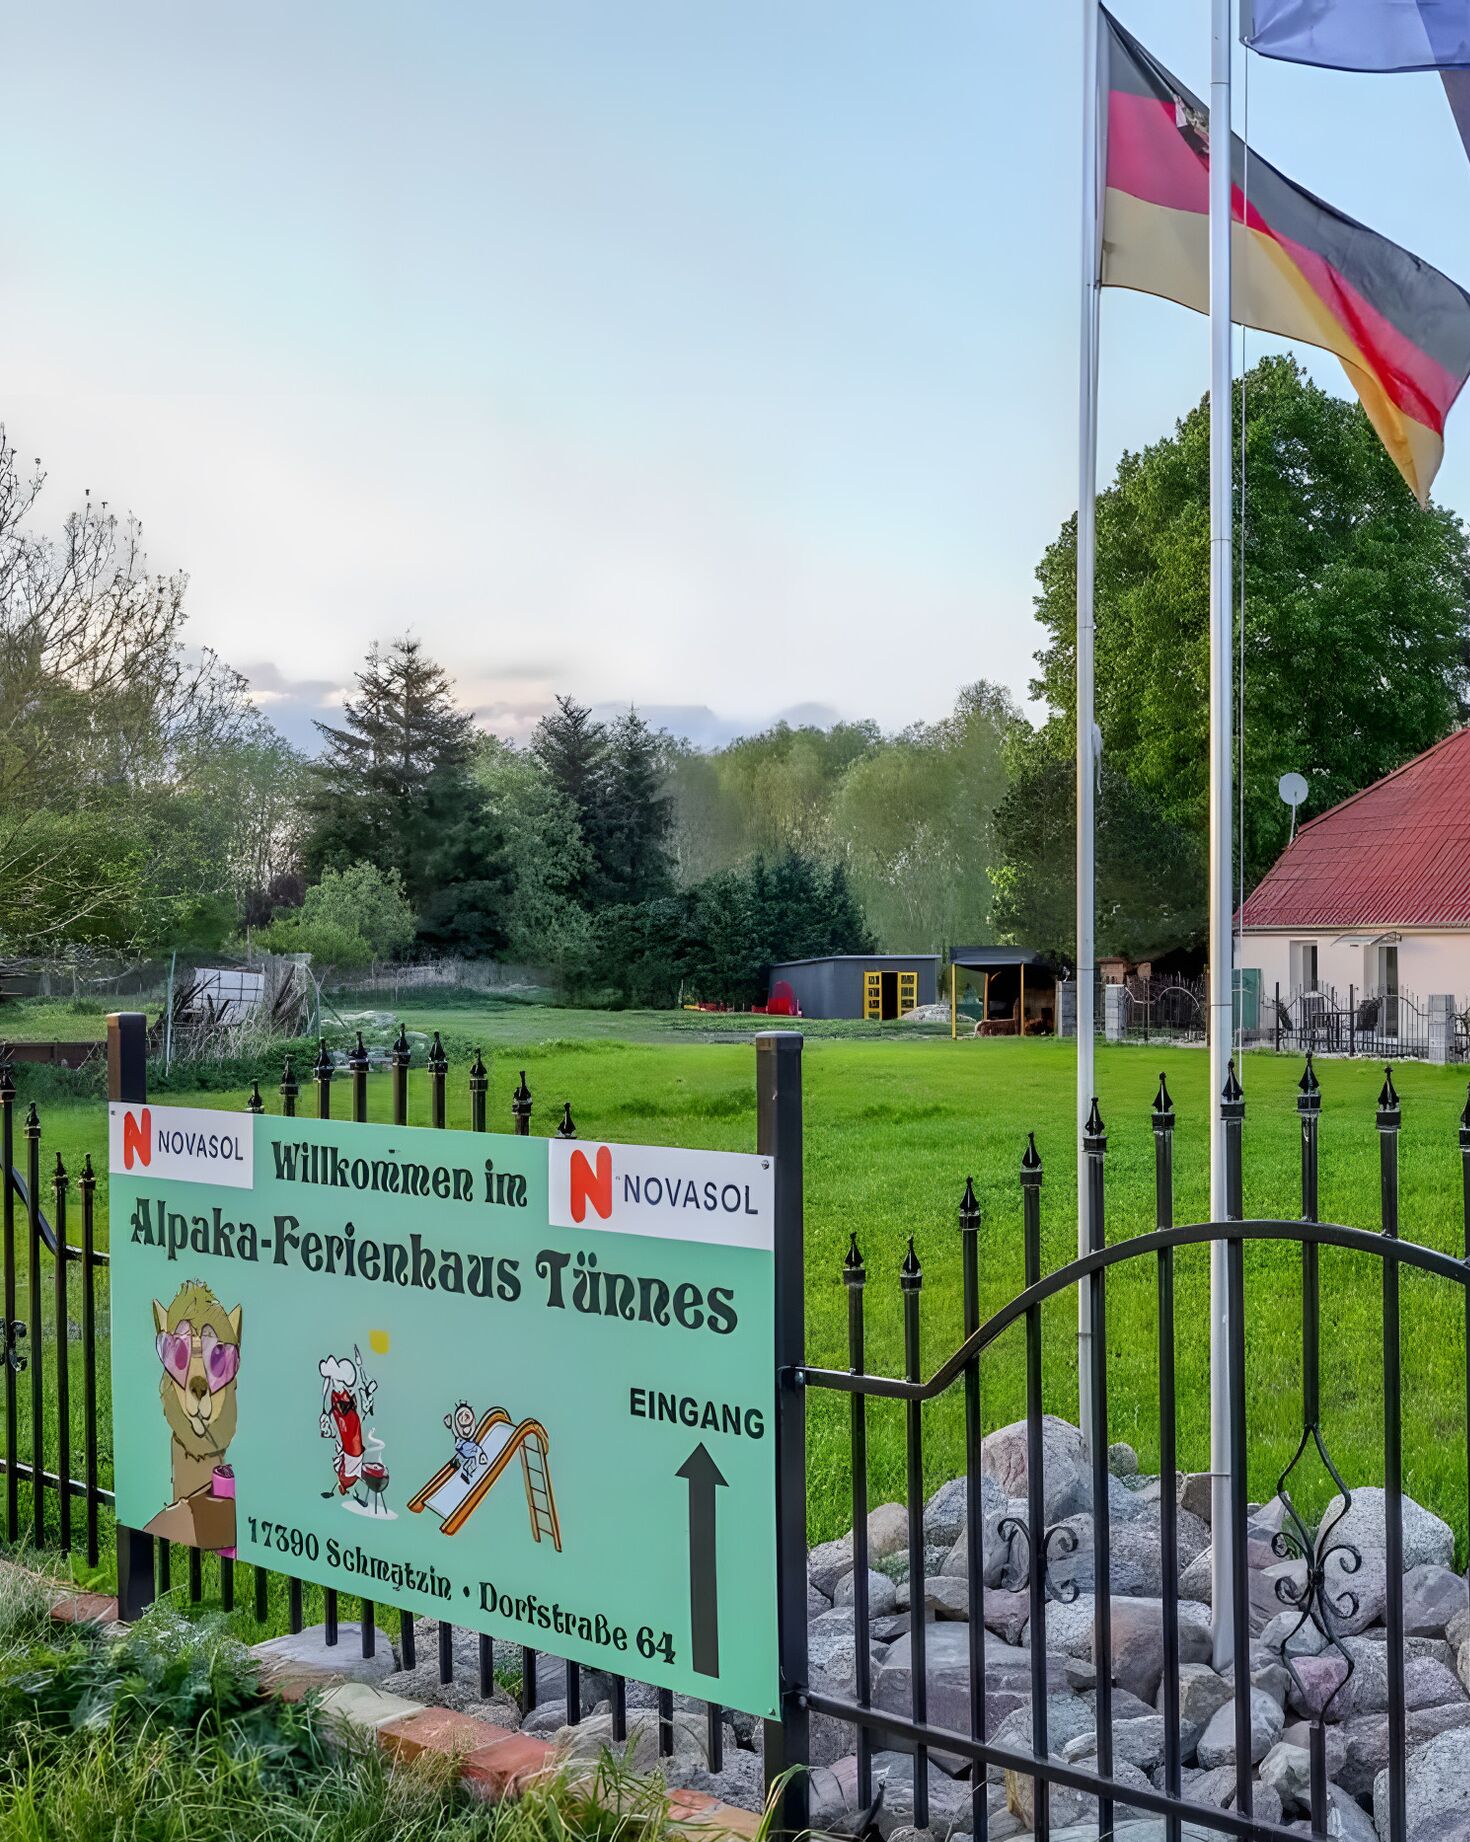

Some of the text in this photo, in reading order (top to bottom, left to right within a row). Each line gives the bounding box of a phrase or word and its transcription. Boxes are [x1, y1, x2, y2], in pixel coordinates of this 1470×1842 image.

[158, 1130, 244, 1161] NOVASOL
[271, 1141, 529, 1208] Willkommen im
[623, 1174, 759, 1216] NOVASOL
[130, 1197, 739, 1335] Alpaka-Ferienhaus Tünnes
[629, 1387, 766, 1441] EINGANG
[247, 1516, 676, 1665] 17390 Schmatzin Dorfstraße 64
